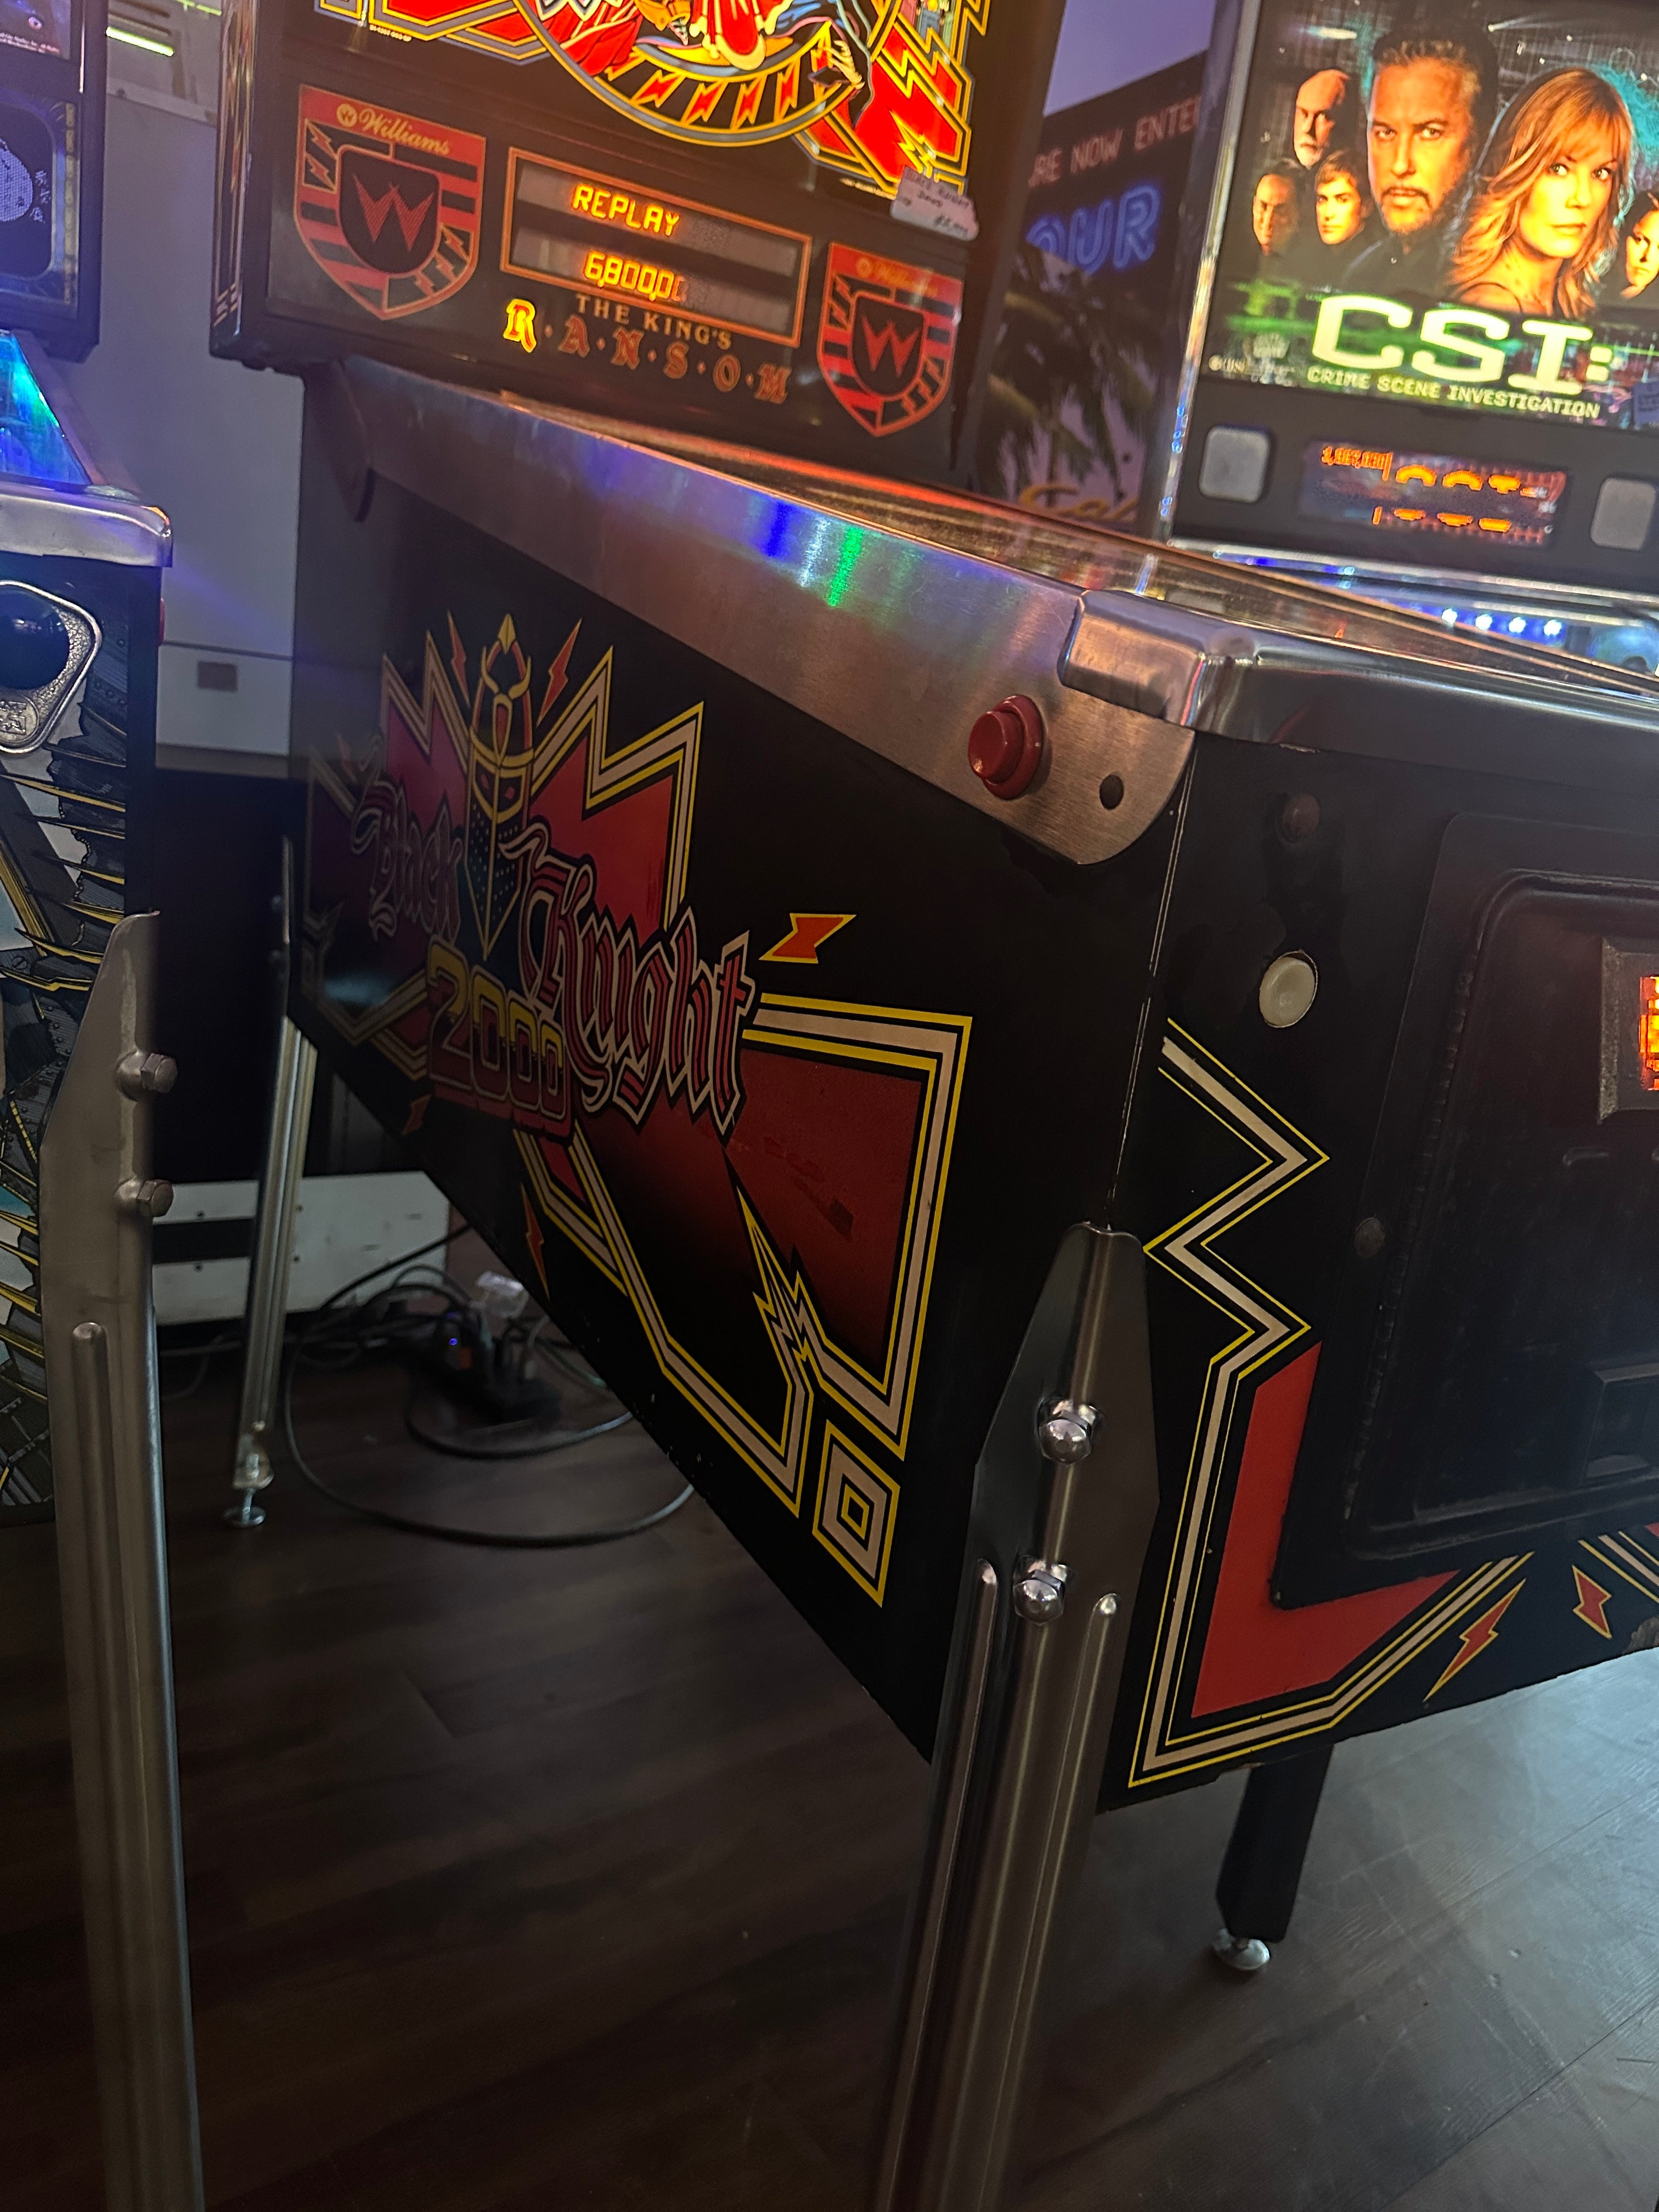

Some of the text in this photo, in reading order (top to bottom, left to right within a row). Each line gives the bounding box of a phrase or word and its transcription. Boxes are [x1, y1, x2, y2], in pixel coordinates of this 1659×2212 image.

[358, 108, 450, 156] Williams
[1028, 94, 1201, 189] RE NOW ENTE
[572, 183, 680, 237] REPLAY
[575, 293, 732, 350] THE KING'S
[1307, 364, 1372, 391] CRIME
[1377, 375, 1443, 399] SCENE
[1447, 385, 1601, 419] INVESTIGATION
[498, 822, 755, 1136] Knight
[427, 943, 571, 1133] 2000
